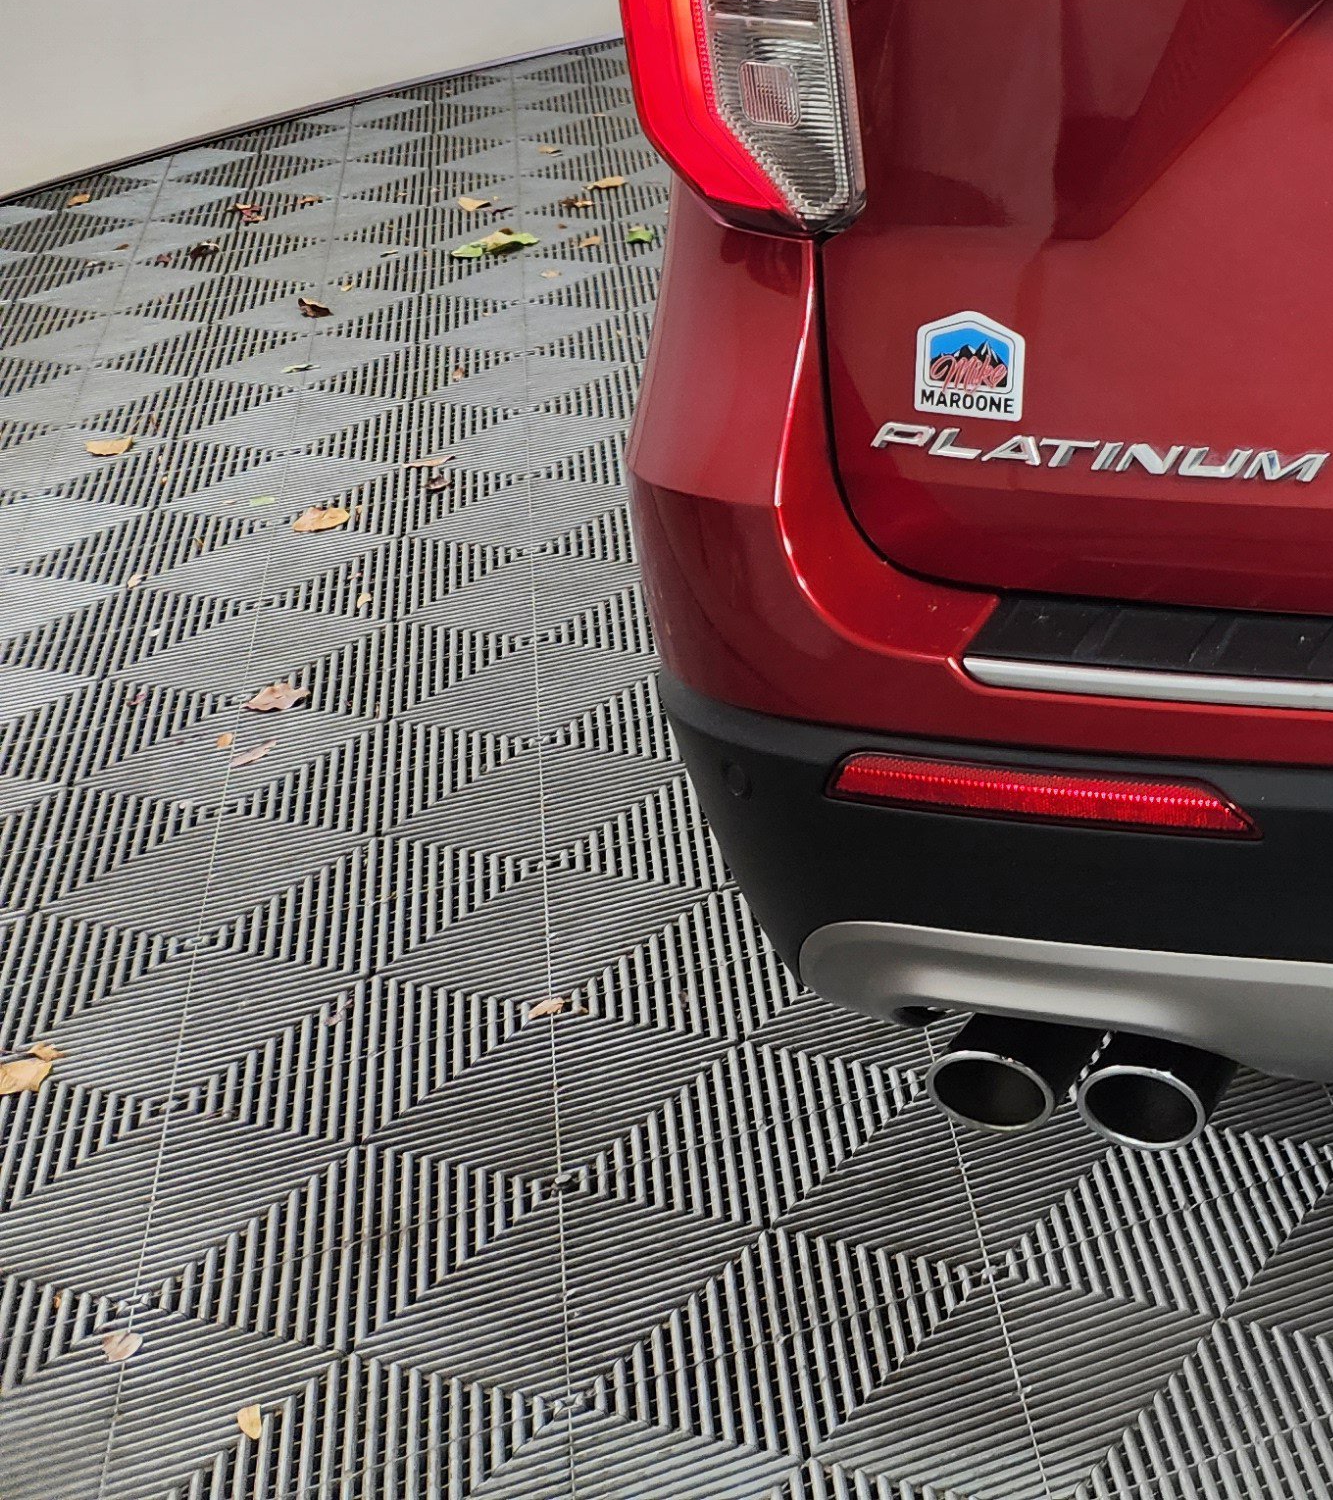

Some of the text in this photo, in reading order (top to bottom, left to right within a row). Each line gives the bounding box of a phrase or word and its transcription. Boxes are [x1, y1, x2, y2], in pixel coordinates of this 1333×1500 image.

[930, 354, 1008, 393] Mike
[920, 388, 1015, 414] MAROONE
[870, 421, 1331, 483] PLATINUM
